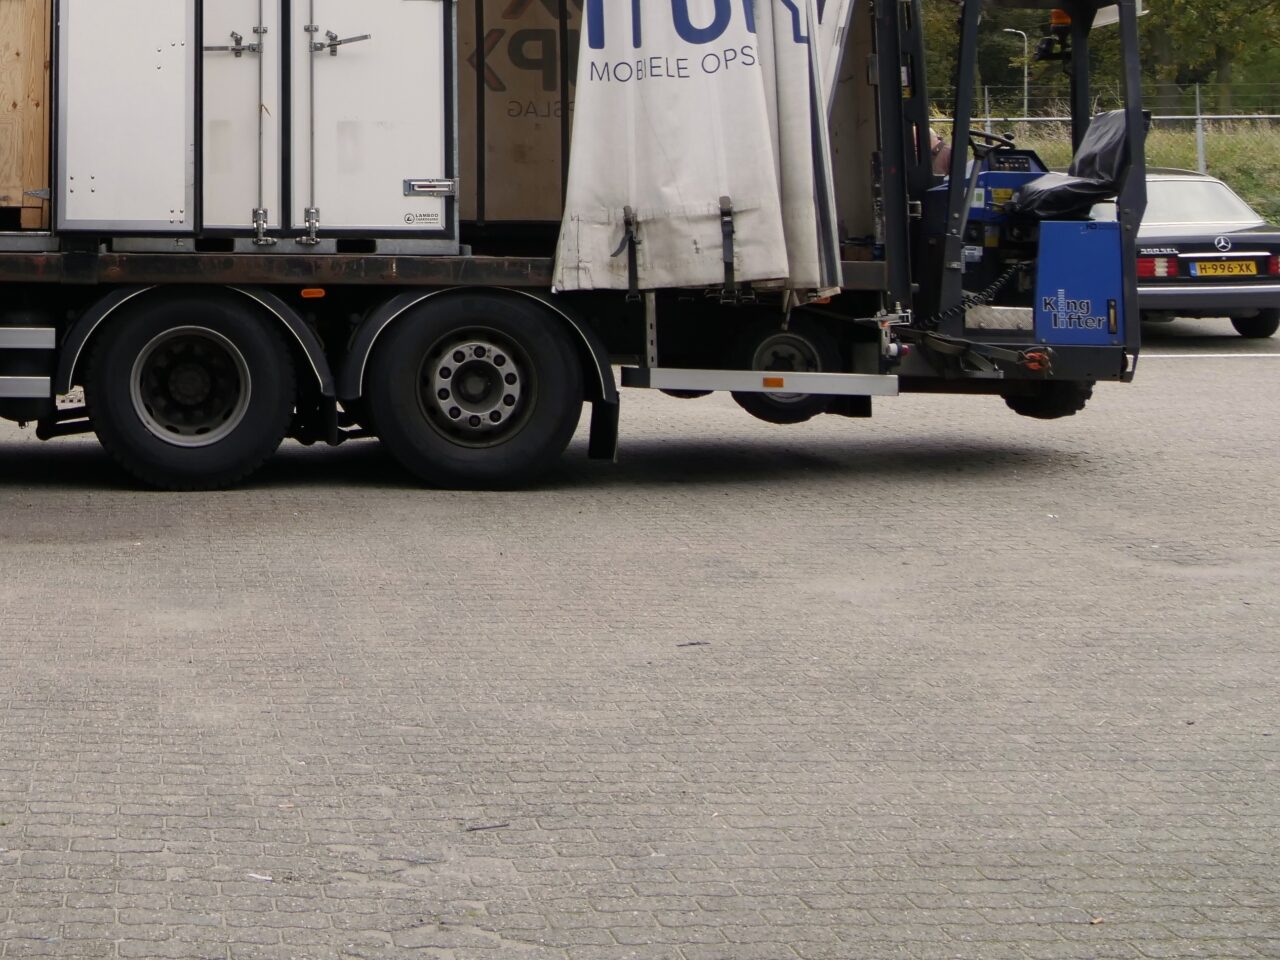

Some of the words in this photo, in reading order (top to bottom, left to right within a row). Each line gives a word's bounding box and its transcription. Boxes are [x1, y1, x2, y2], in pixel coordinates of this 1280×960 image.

[590, 56, 690, 82] MOBIELE
[701, 45, 758, 75] OPS
[1199, 263, 1253, 274] H-996-XK
